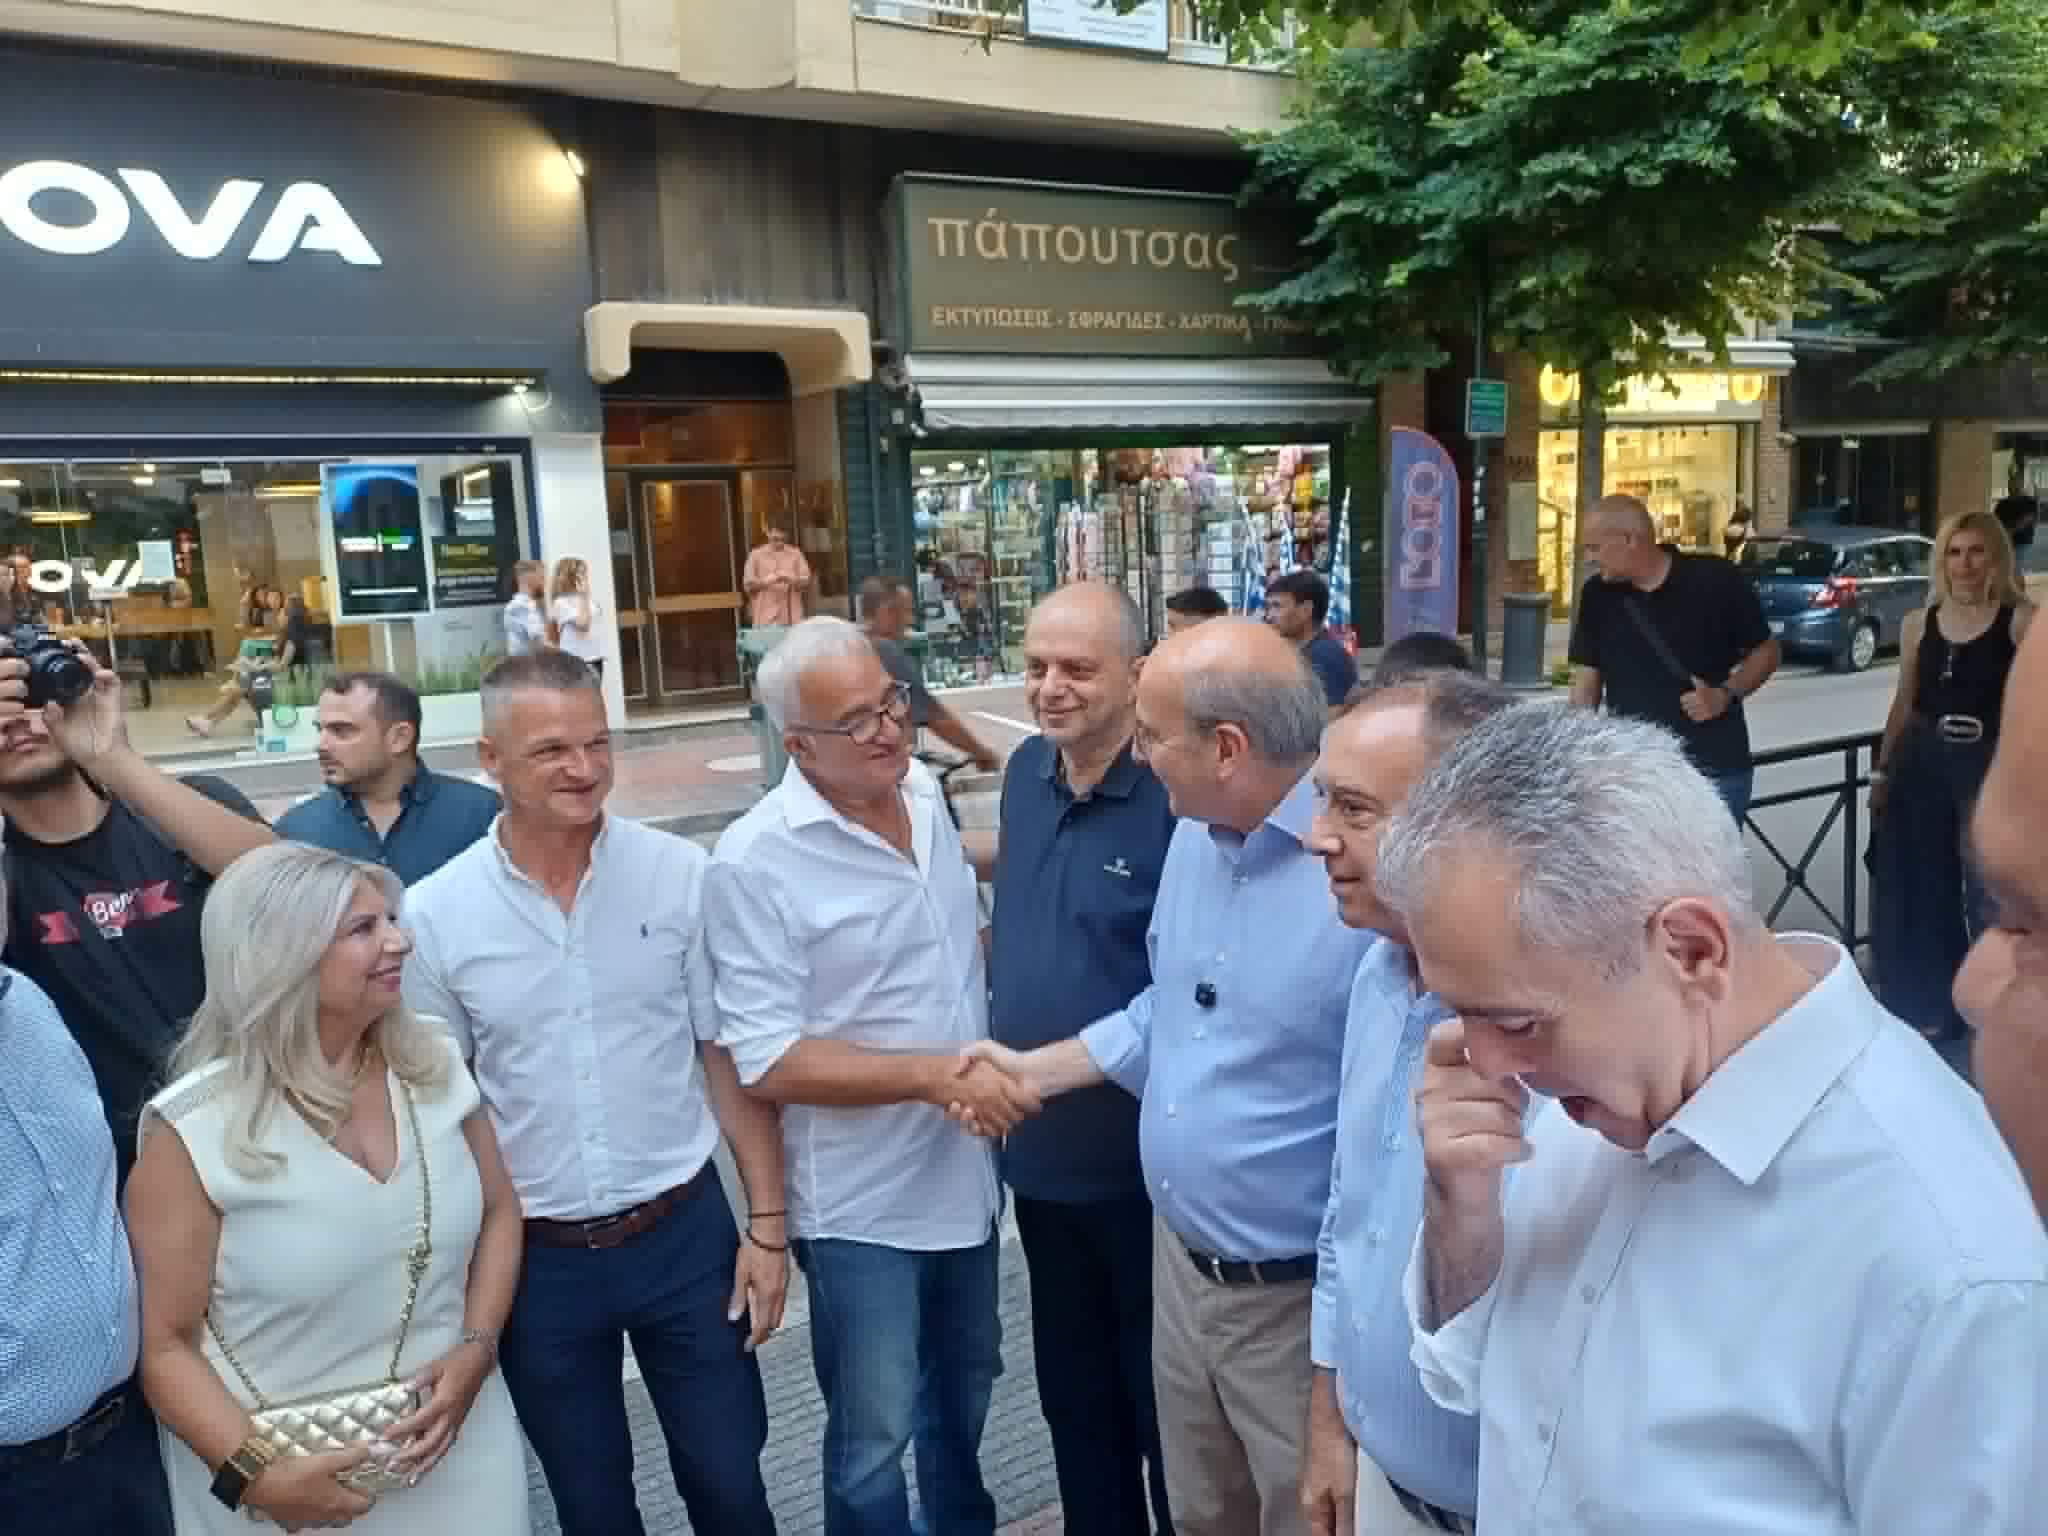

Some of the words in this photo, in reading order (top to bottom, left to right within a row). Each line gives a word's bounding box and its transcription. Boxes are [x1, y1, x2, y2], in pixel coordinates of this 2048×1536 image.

[0, 159, 384, 266] OVA
[927, 207, 1239, 283] πάπουτσας
[930, 305, 1053, 328] ΕΚΤΥΠΩΣΕΙΣ
[1068, 310, 1166, 330] ΣΦΡΑΓΙΔΕΣ
